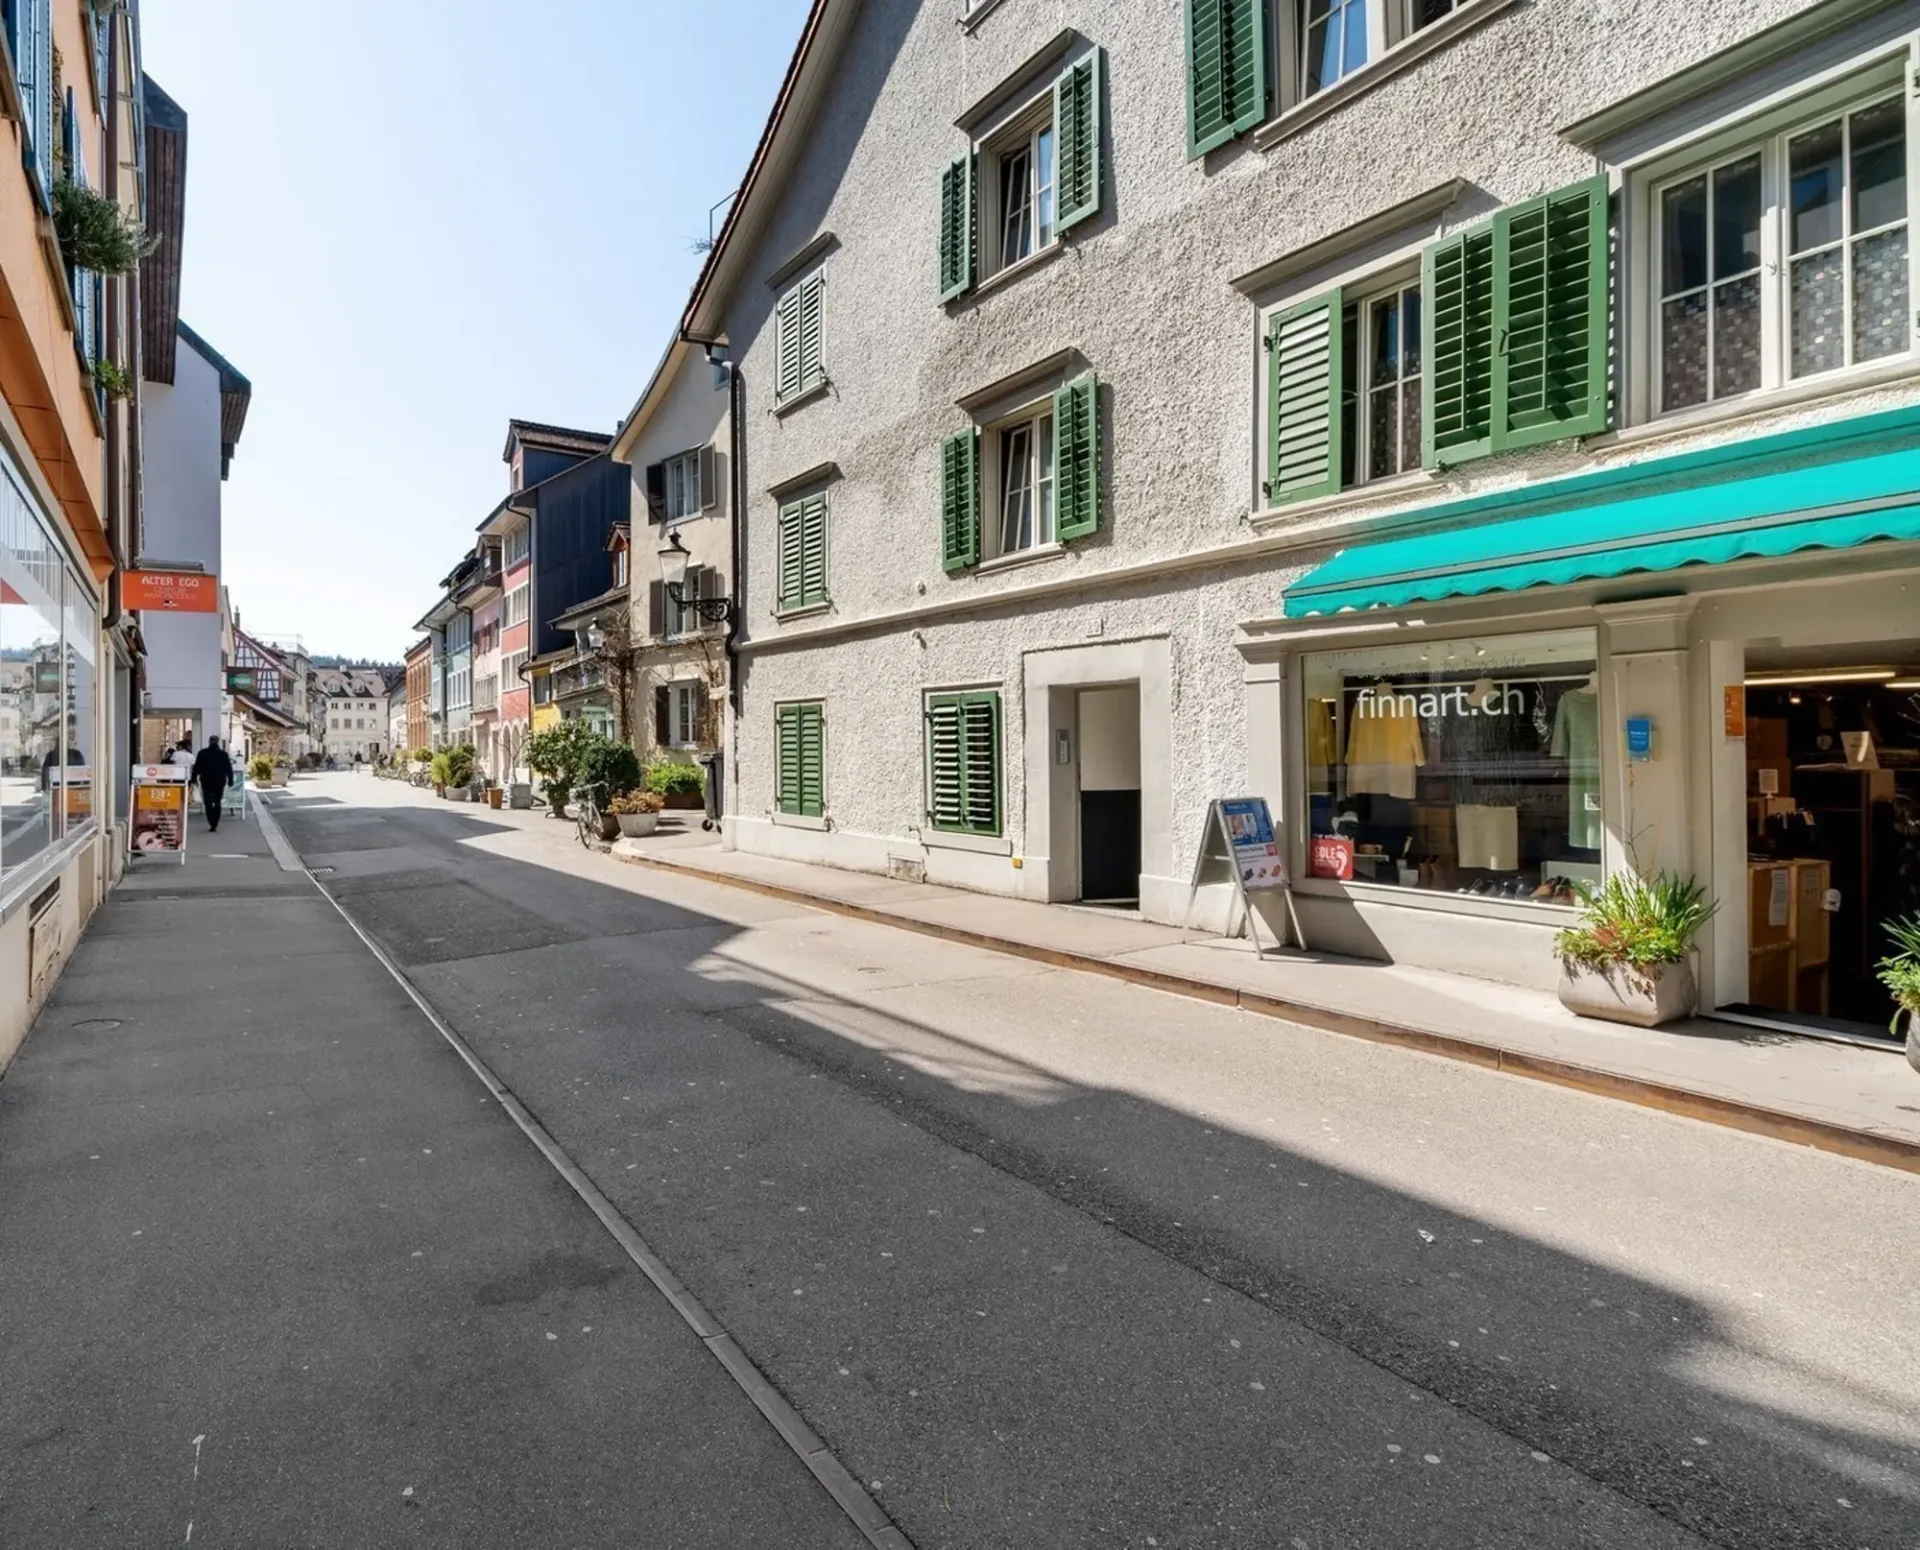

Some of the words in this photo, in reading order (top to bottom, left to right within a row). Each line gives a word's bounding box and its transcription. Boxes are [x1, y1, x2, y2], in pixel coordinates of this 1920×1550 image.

[141, 575, 174, 586] ALTER
[178, 577, 200, 588] EGO
[1087, 620, 1100, 633] 29
[1356, 683, 1525, 719] finnart.ch
